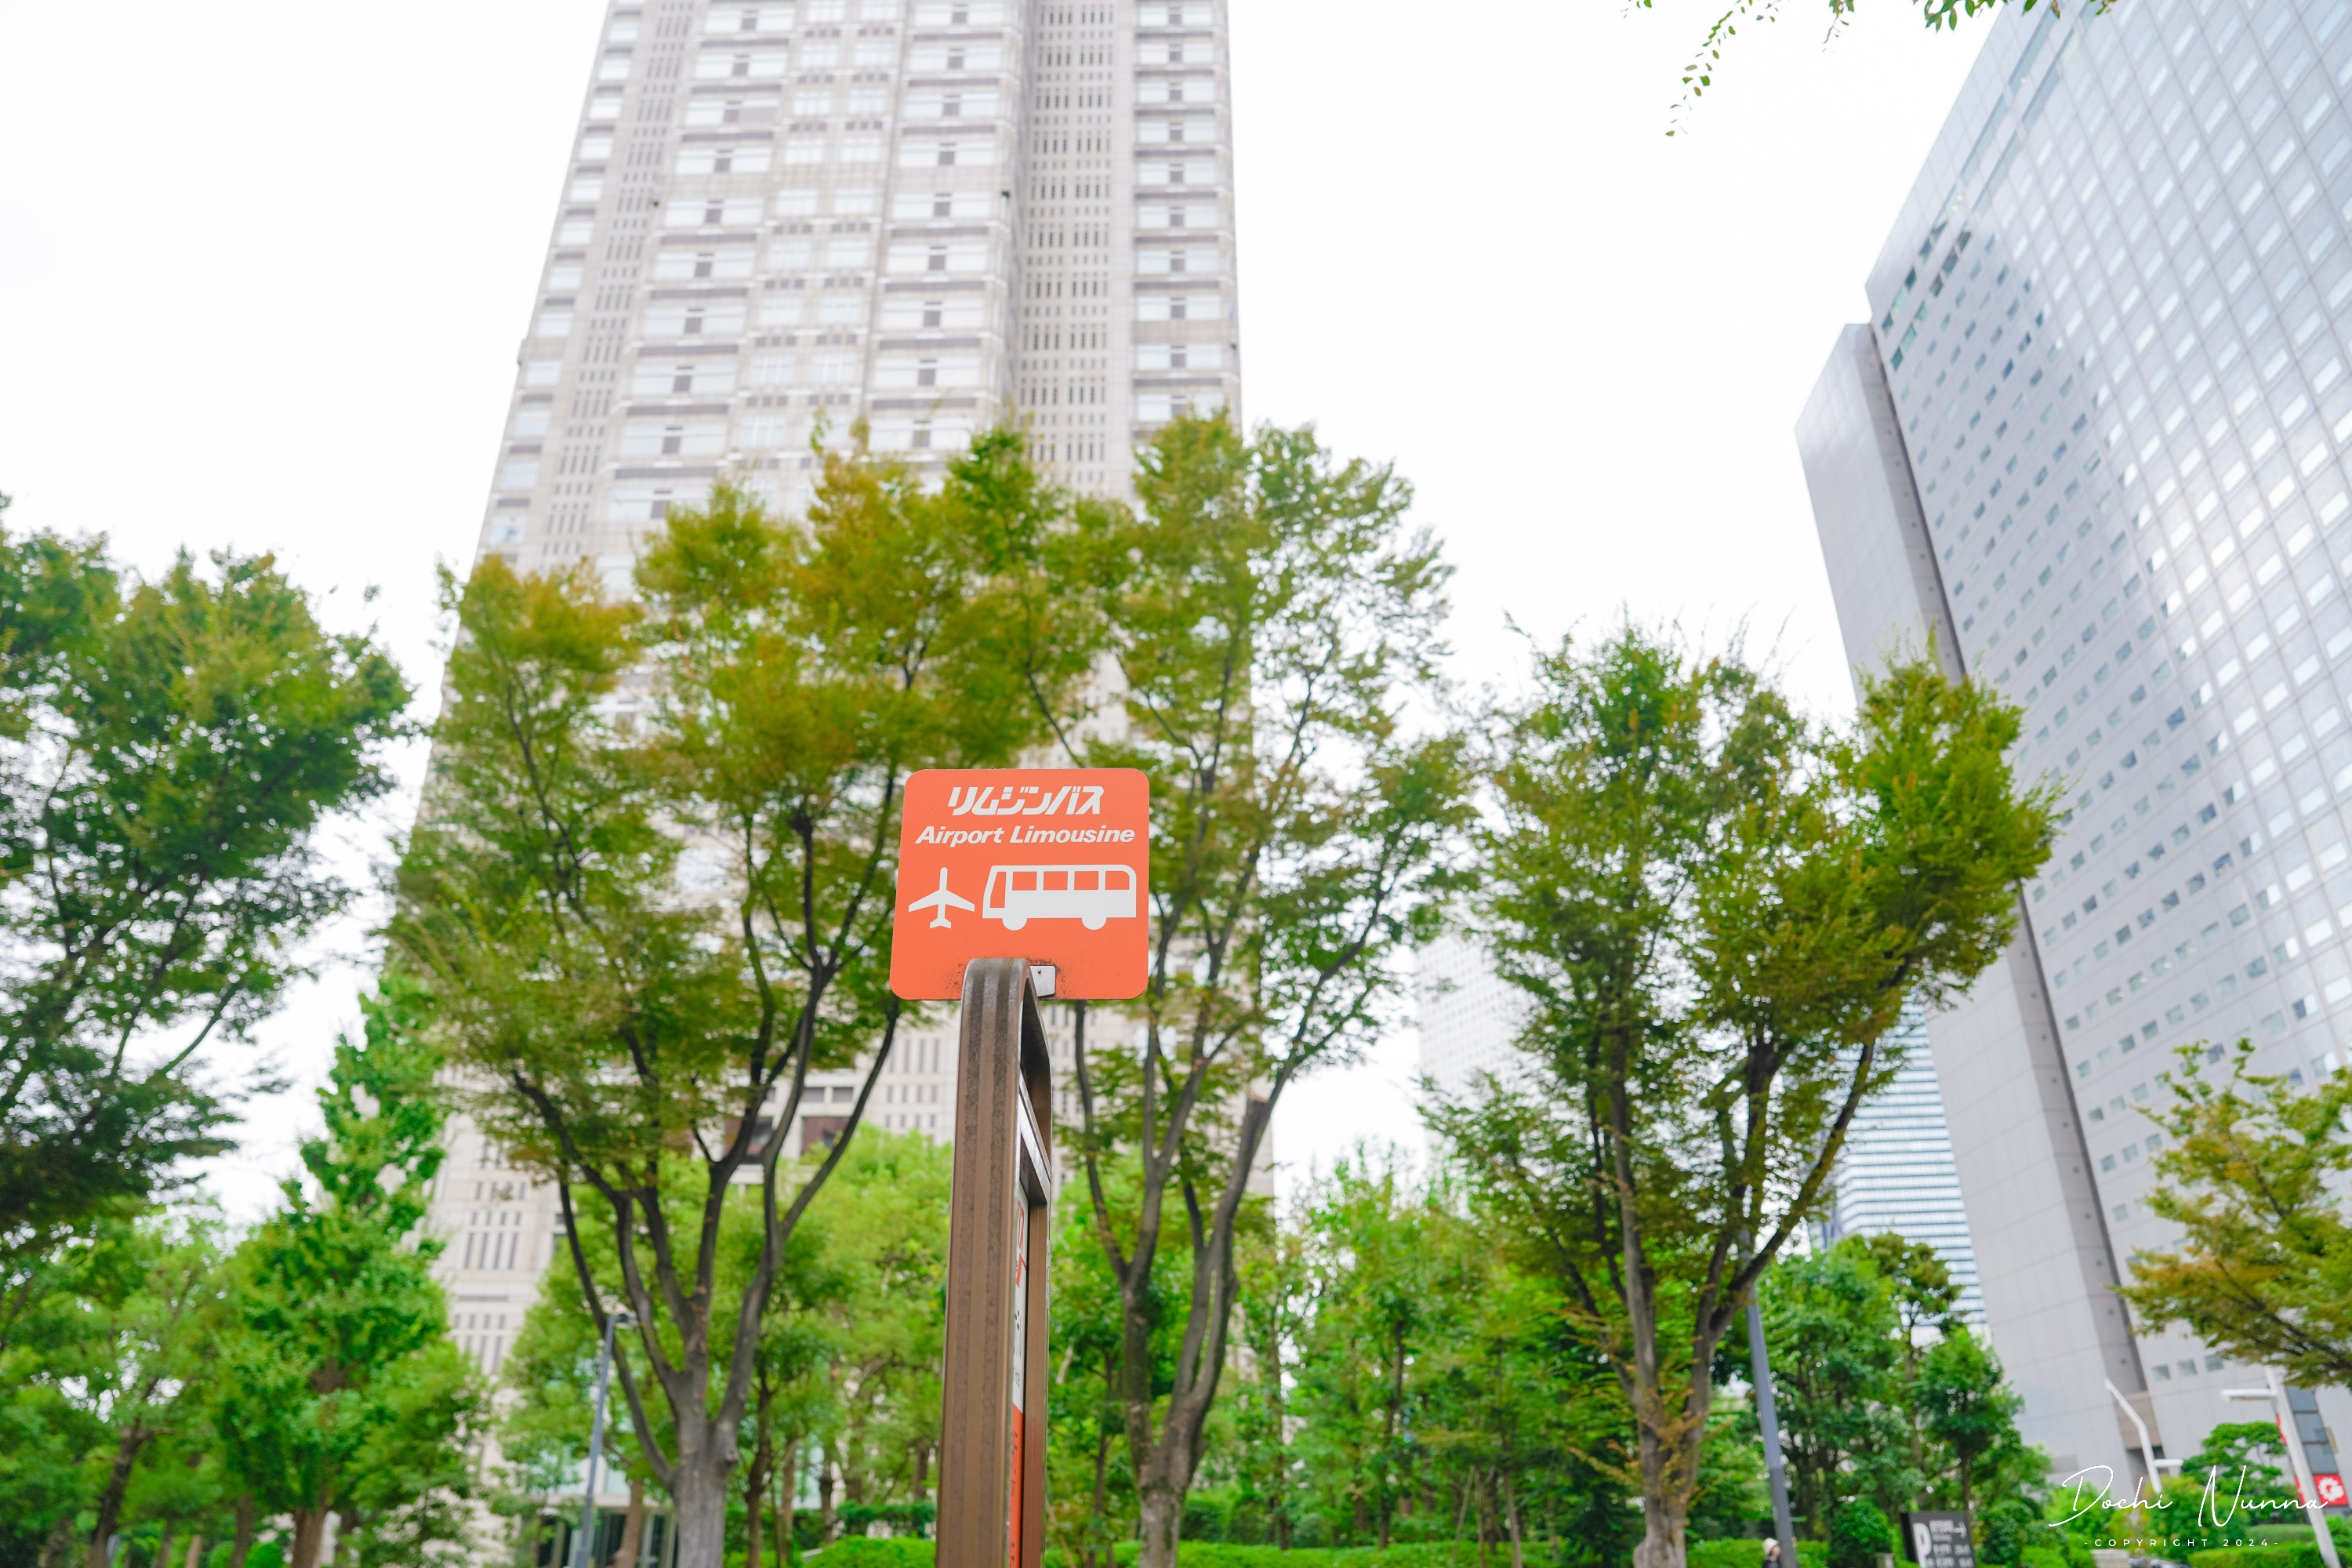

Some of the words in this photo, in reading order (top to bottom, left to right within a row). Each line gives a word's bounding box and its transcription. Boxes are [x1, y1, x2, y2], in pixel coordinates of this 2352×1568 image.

[947, 786, 1105, 816] リムジンバス
[914, 826, 1004, 848] Airport
[1009, 825, 1135, 844] Limousine
[1913, 1523, 1932, 1568] P
